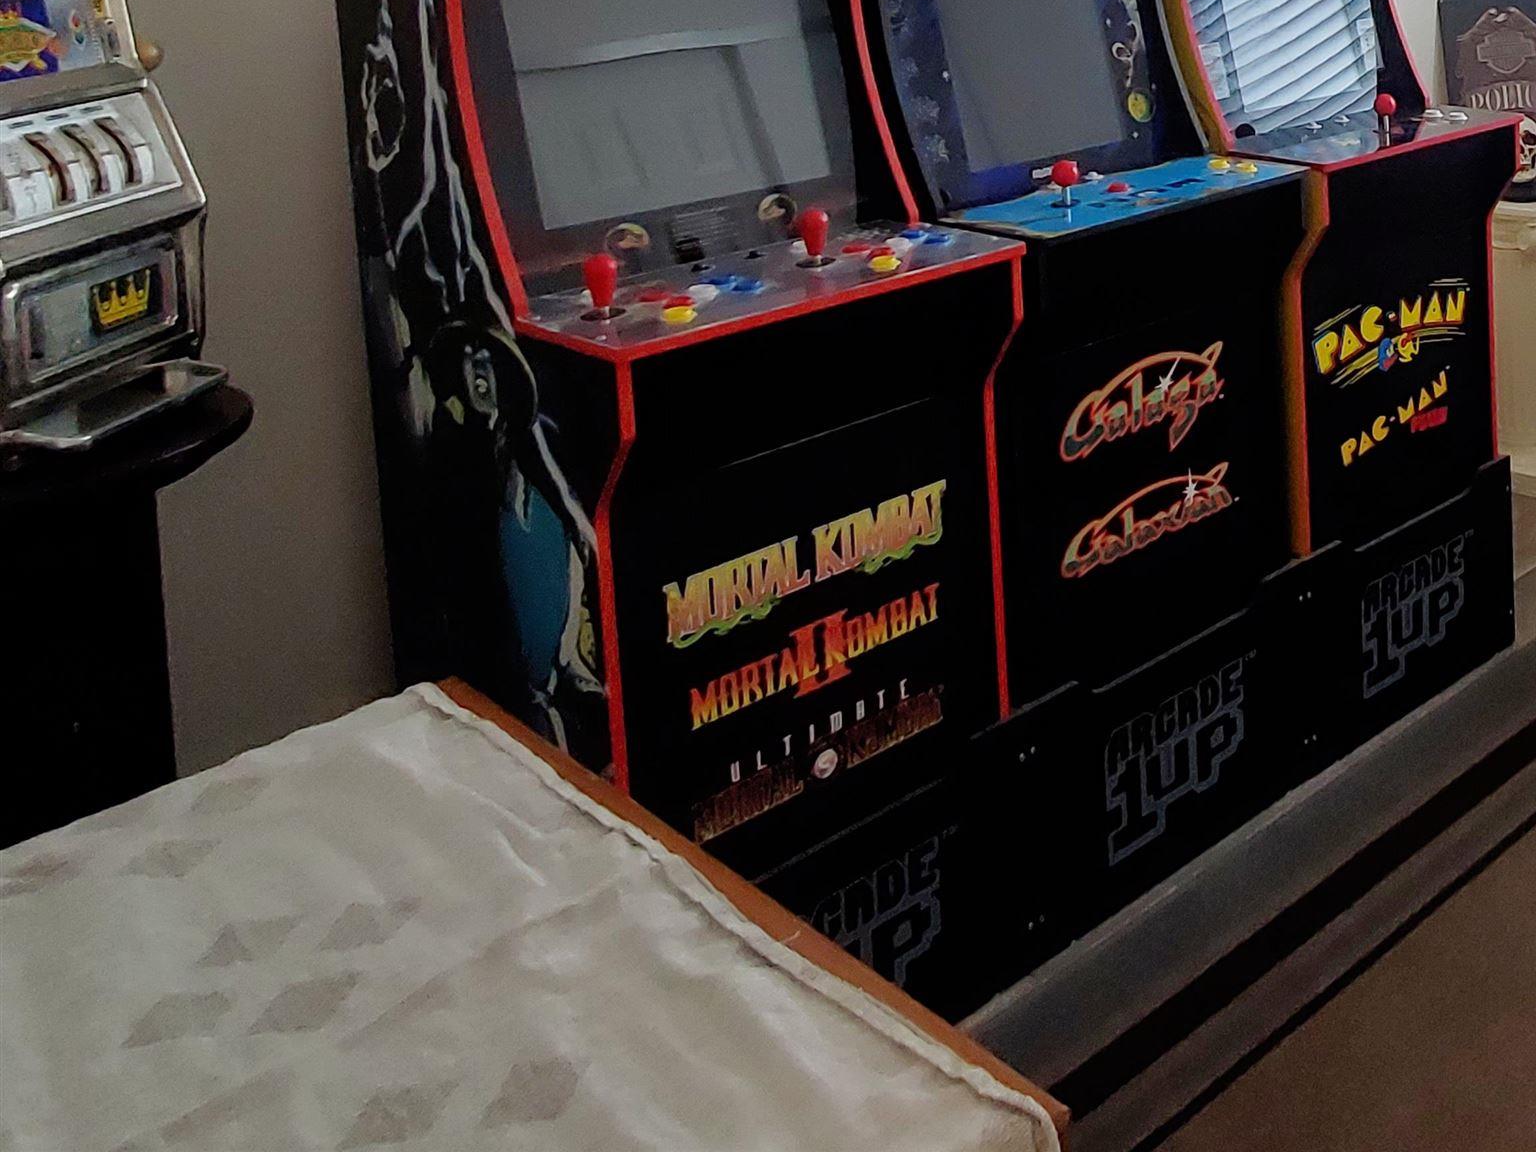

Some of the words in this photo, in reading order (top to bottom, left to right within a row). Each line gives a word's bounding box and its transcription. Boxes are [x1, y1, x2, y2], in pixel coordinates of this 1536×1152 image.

[1312, 290, 1466, 375] PAC-MAN
[1061, 341, 1224, 462] Galaga
[1341, 370, 1448, 466] PAC-MAN
[662, 535, 810, 644] MORTAL
[812, 478, 947, 582] KOMBAT
[1362, 534, 1464, 630] ARCADE
[690, 645, 820, 732] MORTAL
[824, 583, 940, 670] KOMBAT
[1362, 576, 1464, 699] 1UP
[730, 677, 910, 783] ULTIMATE
[1104, 657, 1244, 778] ARCADE
[1104, 709, 1245, 866] 1UP
